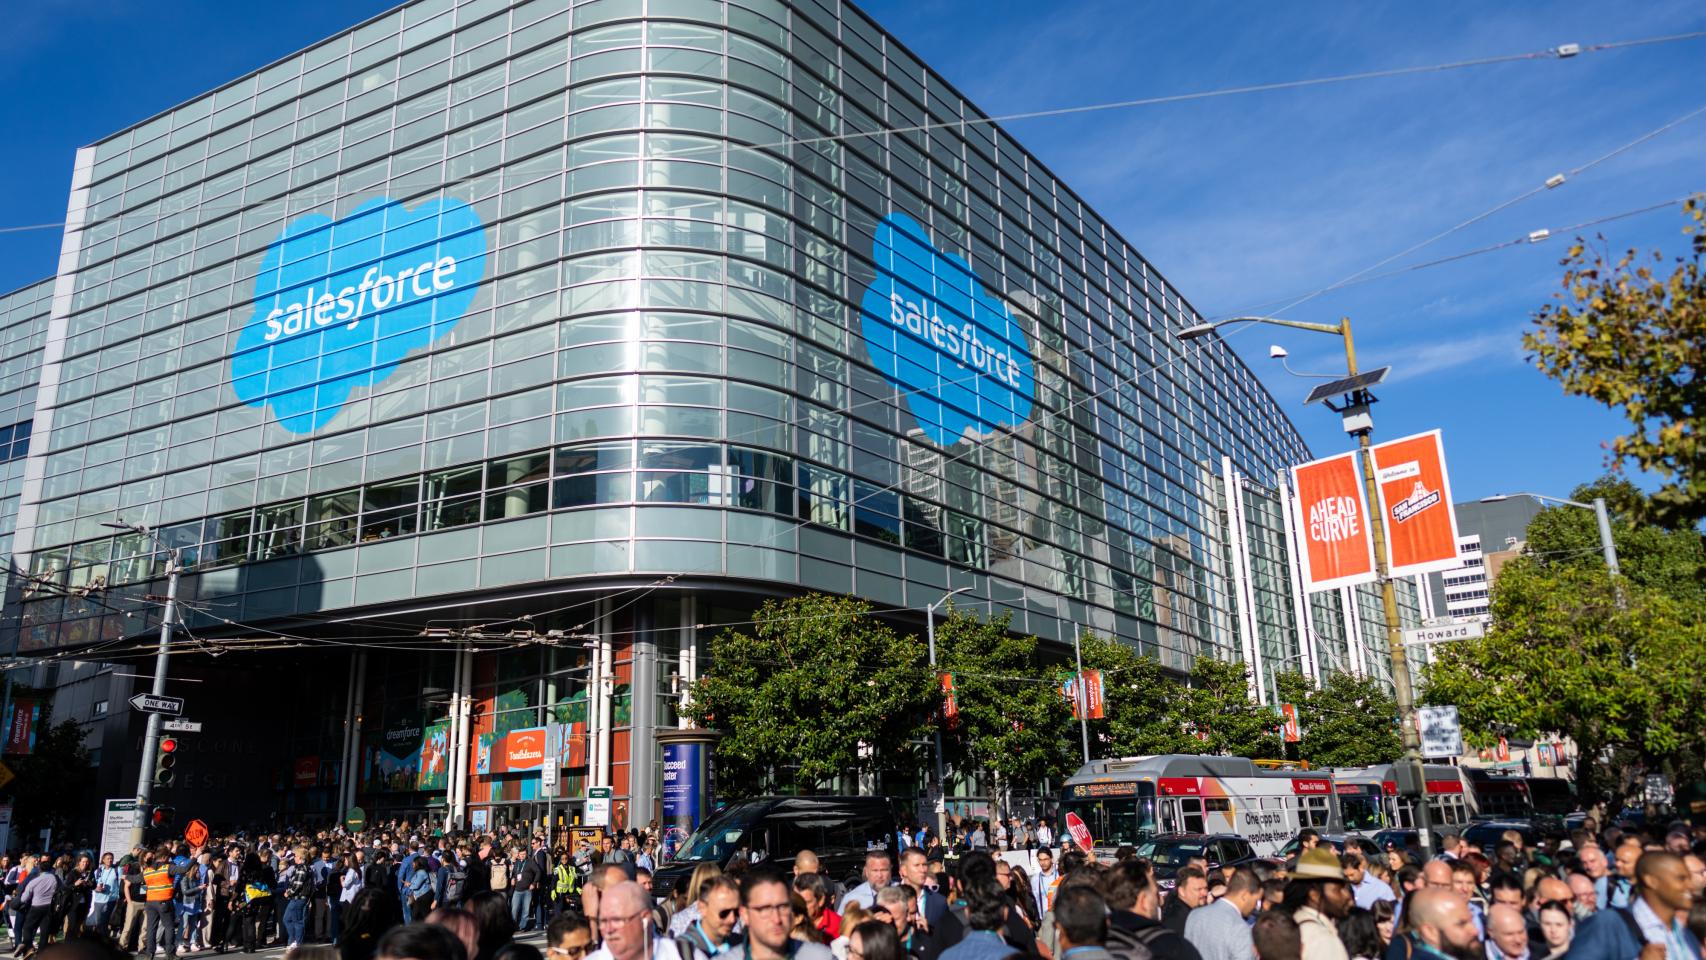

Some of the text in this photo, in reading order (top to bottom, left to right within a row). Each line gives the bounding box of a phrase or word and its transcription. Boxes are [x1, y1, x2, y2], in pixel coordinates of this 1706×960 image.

[264, 252, 457, 342] salesforce
[890, 292, 1020, 388] salesforce
[1310, 496, 1357, 524] AHEAD
[1393, 500, 1409, 515] SAN
[1399, 493, 1438, 520] FRANCISCO
[1311, 515, 1359, 542] CURVE
[1417, 627, 1467, 640] Howard
[144, 699, 177, 710] ONE WAY
[386, 726, 420, 741] dreamforce
[663, 760, 687, 770] ucceed
[663, 771, 678, 781] aster
[1245, 811, 1281, 827] One app to
[188, 828, 204, 841] SLOW
[1070, 823, 1088, 842] STOP
[1248, 830, 1273, 847] replace
[1272, 829, 1290, 842] them
